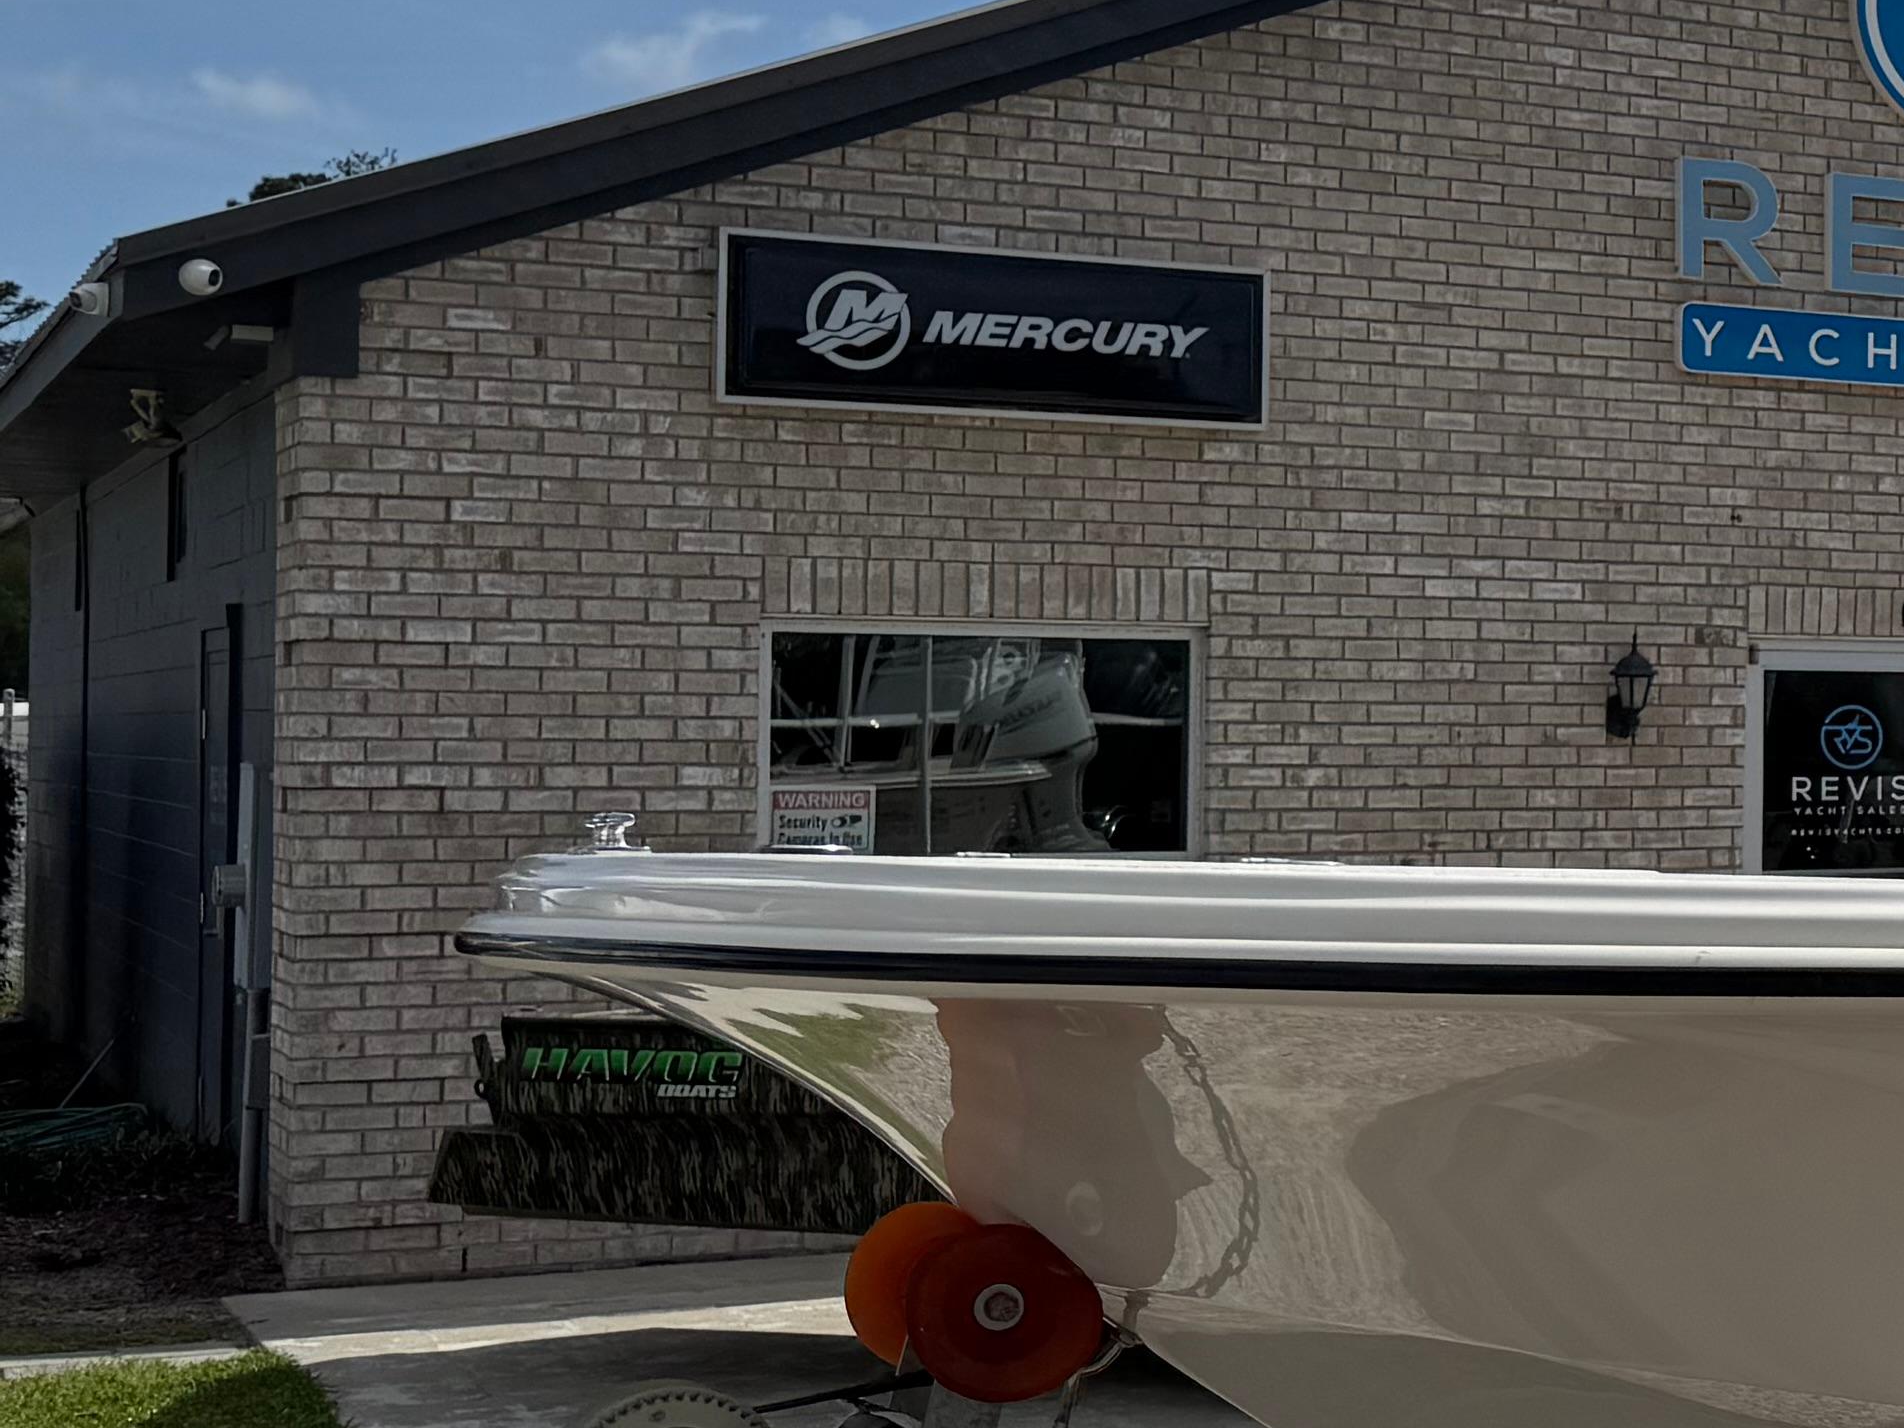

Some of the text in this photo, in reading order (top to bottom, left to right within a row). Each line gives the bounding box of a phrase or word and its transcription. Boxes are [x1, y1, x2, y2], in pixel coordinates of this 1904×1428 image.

[922, 310, 1210, 359] MERCURY
[779, 792, 865, 809] WARNING
[1793, 805, 1847, 816] YACHT
[779, 815, 828, 832] Security
[522, 1047, 743, 1083] HAVOC
[656, 1084, 738, 1100] BOATS
